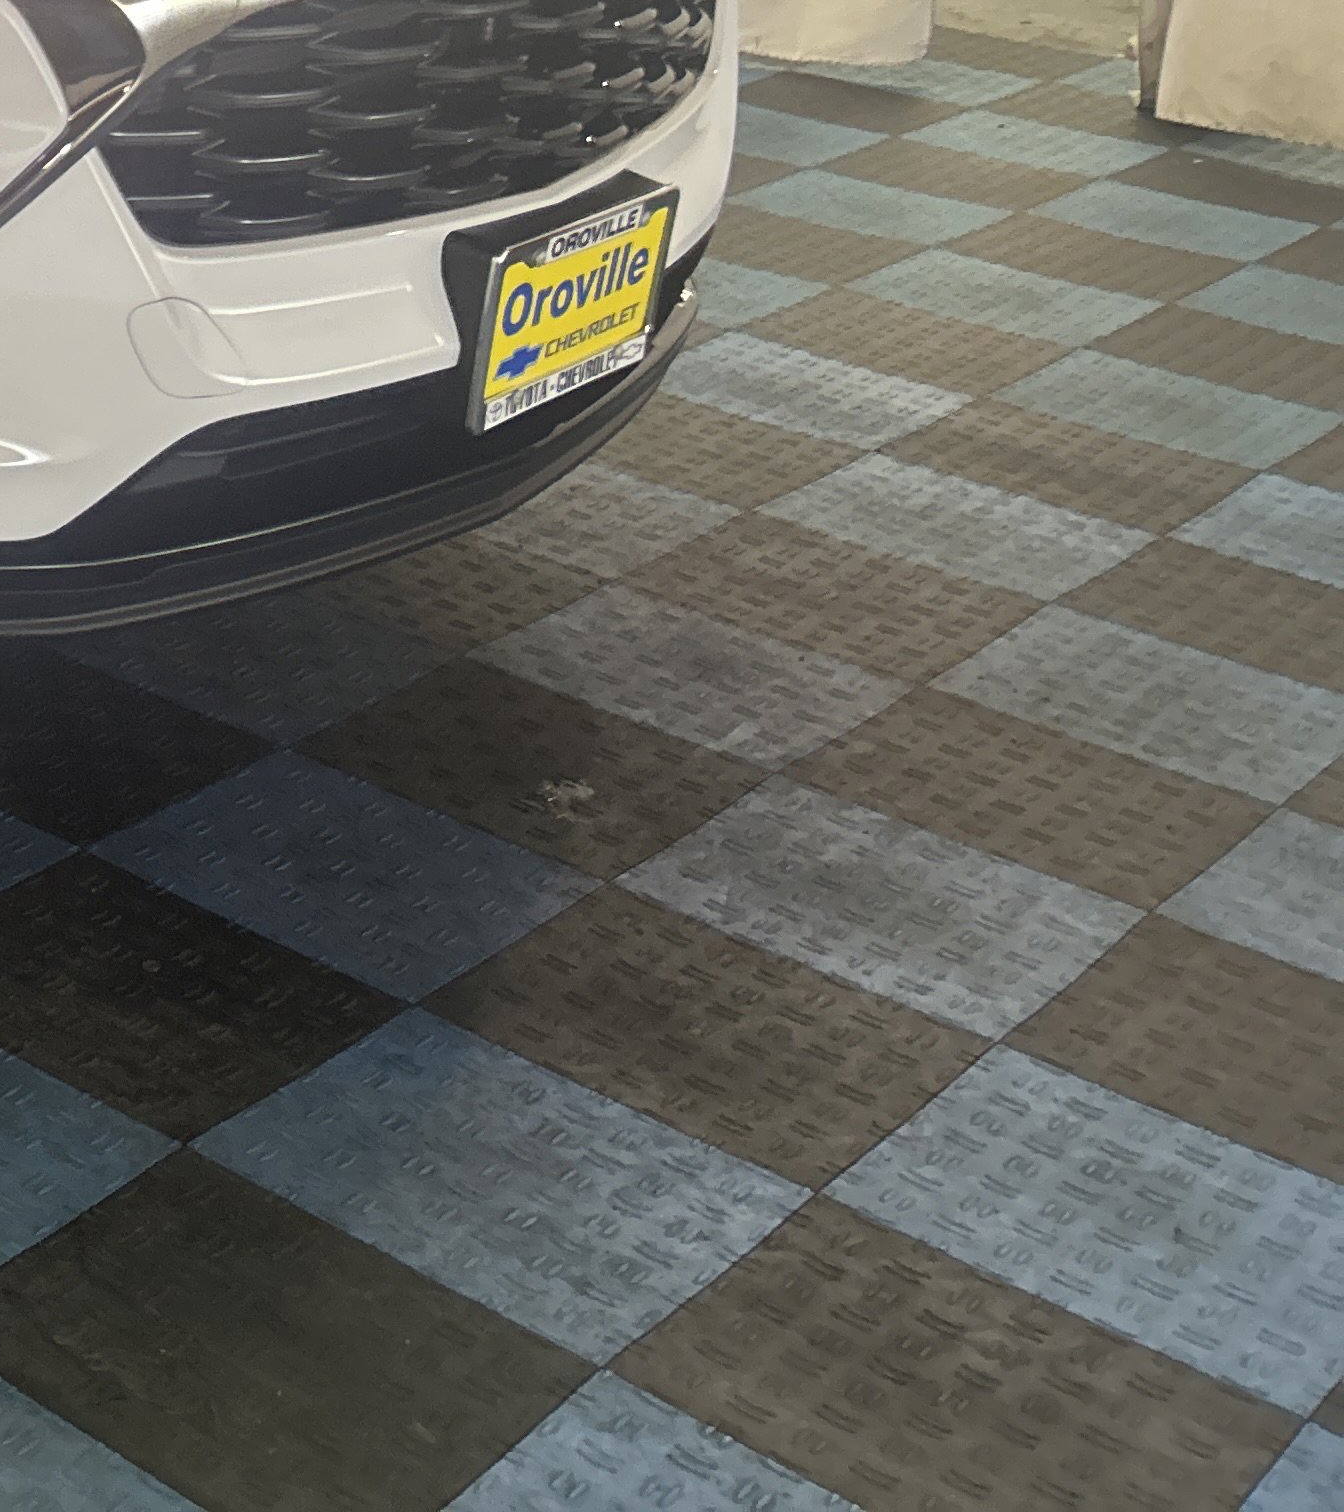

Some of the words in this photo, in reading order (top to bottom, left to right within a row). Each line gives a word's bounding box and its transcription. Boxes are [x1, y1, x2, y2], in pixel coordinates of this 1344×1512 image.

[551, 205, 639, 257] OROVILLE
[502, 242, 649, 337] Oroville
[544, 301, 640, 358] CHEVROLET
